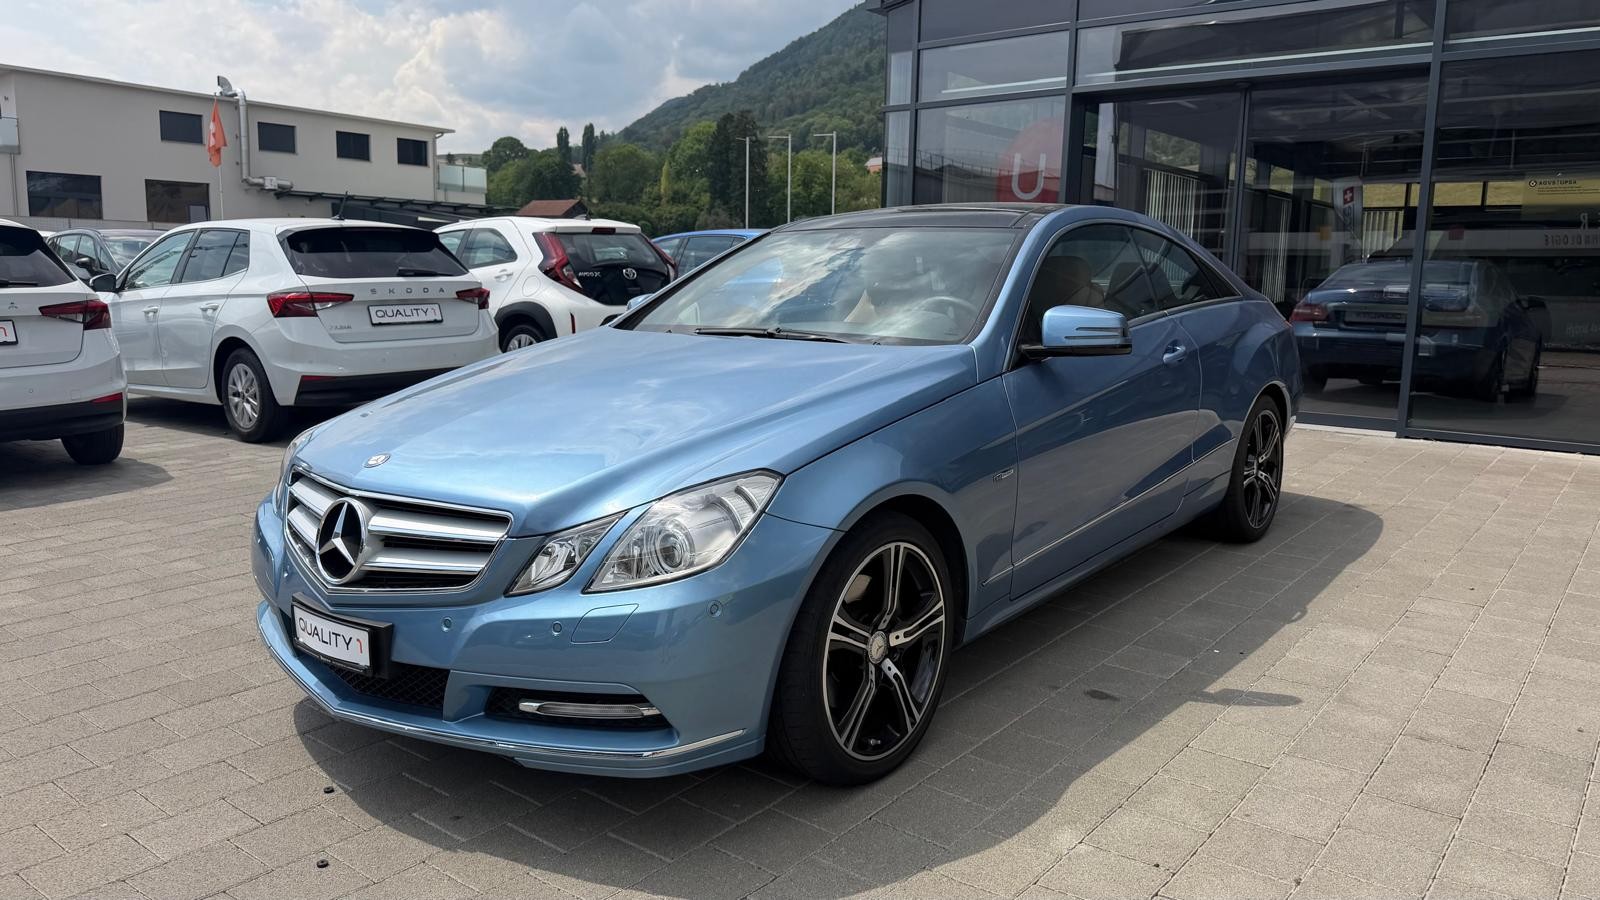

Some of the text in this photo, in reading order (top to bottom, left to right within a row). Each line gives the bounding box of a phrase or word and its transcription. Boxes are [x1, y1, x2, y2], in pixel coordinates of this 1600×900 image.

[375, 308, 429, 318] QUALITY
[299, 617, 363, 654] QUALITY 1
